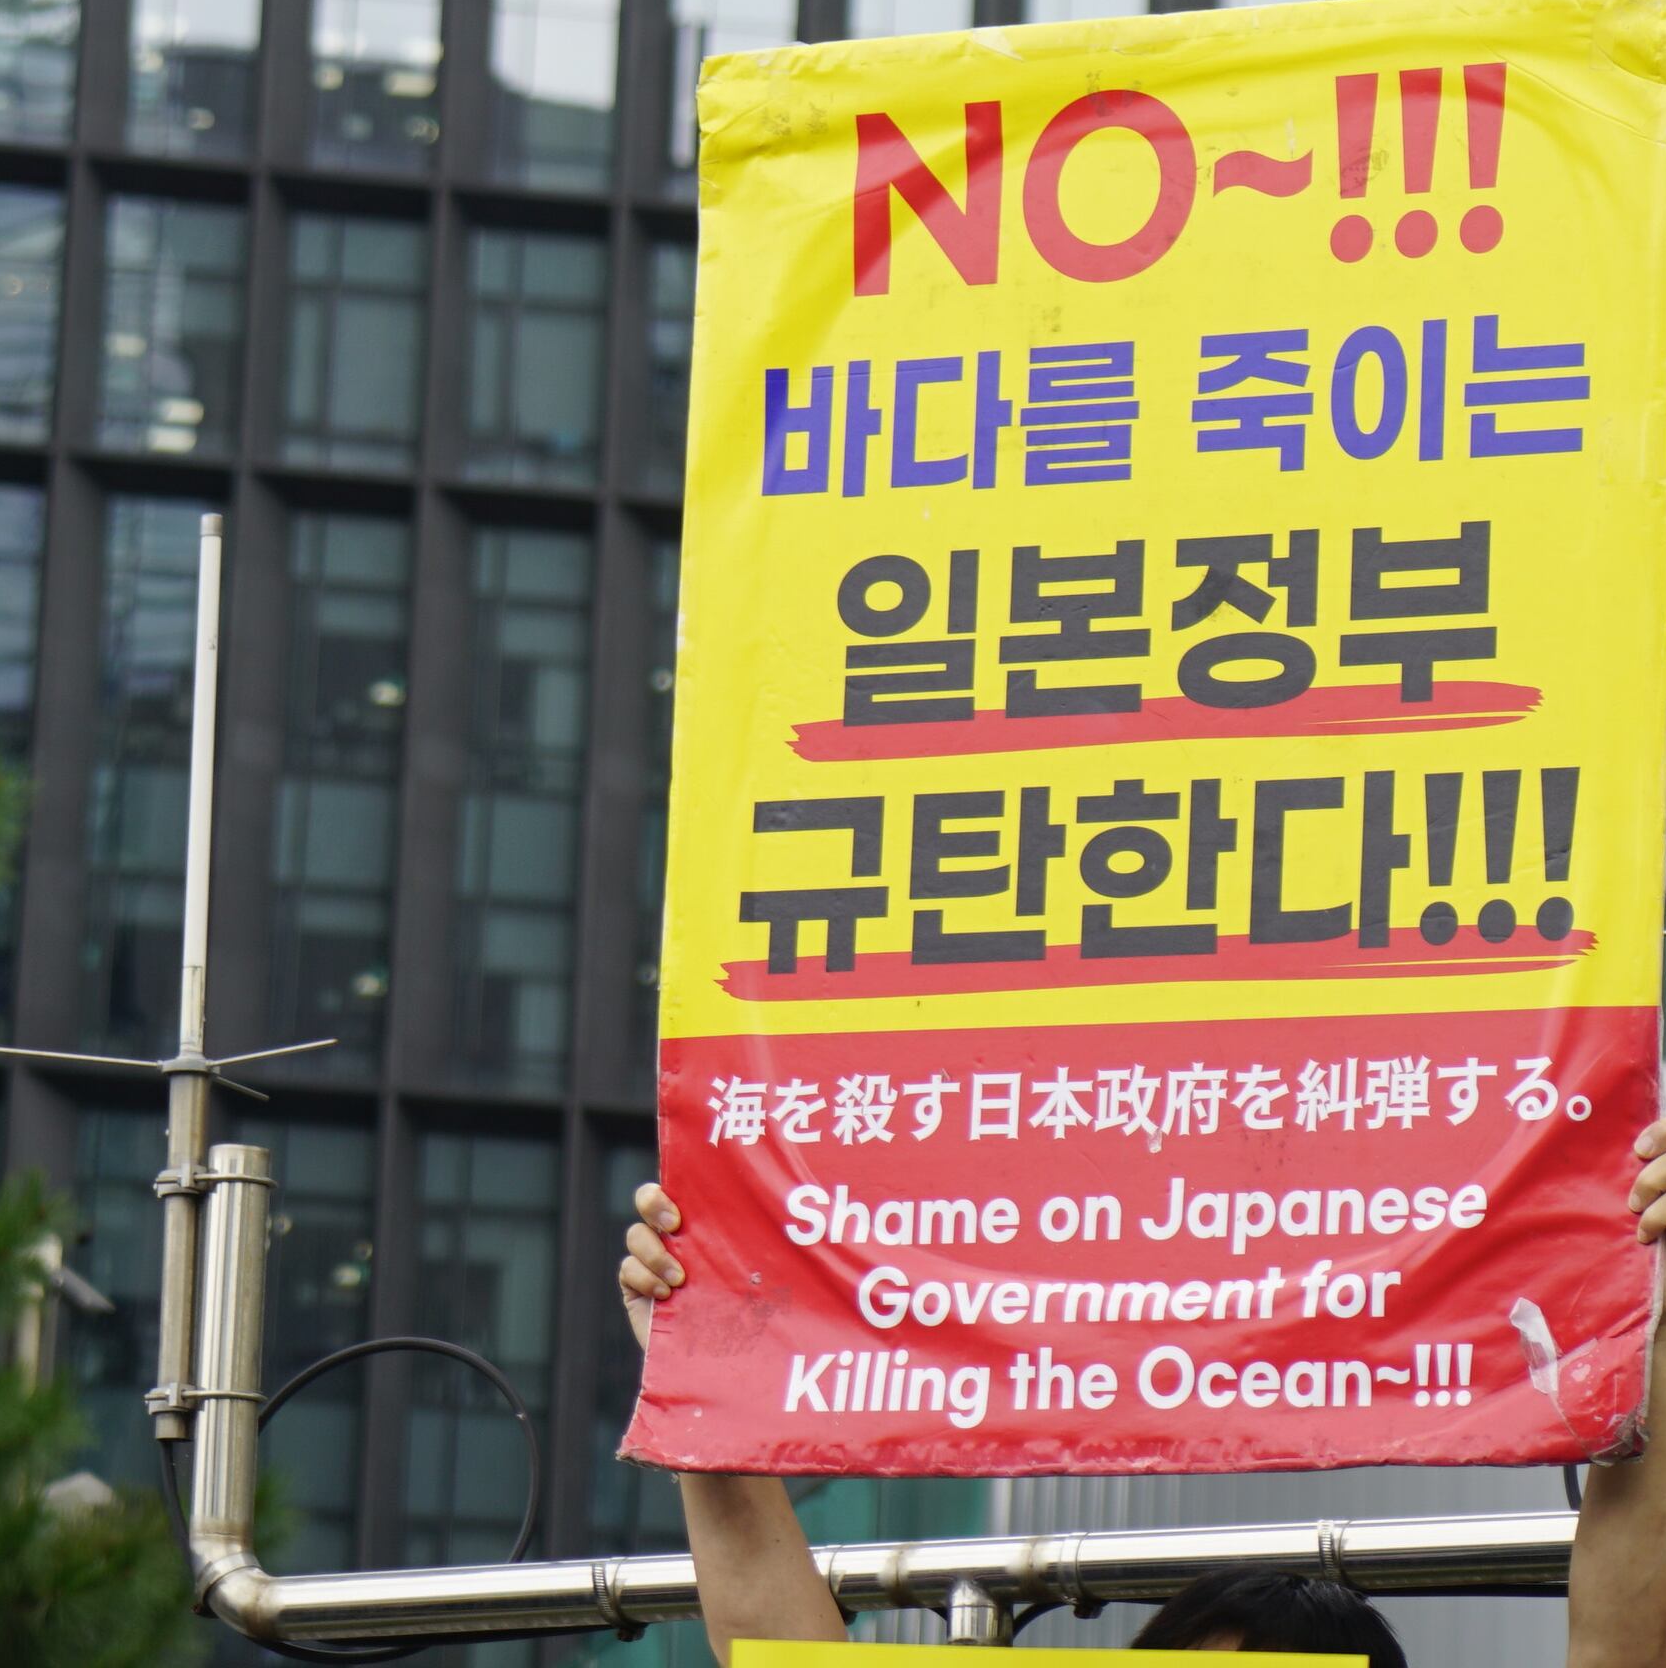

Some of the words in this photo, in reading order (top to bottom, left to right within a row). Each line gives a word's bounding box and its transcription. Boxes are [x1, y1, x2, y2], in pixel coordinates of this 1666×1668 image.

[853, 62, 1507, 296] NO~!!!
[761, 341, 1139, 497] 바다를
[1191, 314, 1590, 472] 죽이는
[836, 520, 1497, 727] 일본정부
[738, 766, 1581, 975] 규탄한다!!!
[706, 1055, 1593, 1147] 海を殺す日本政府を糾弾する。
[785, 1181, 1021, 1247] Shame
[1037, 1193, 1124, 1243] on
[1139, 1175, 1489, 1256] Japanese
[856, 1264, 1286, 1330] Government
[1299, 1257, 1403, 1320] for
[782, 1346, 992, 1430] Killing
[1007, 1345, 1120, 1412] the
[1136, 1342, 1475, 1411] Ocean~!!!
